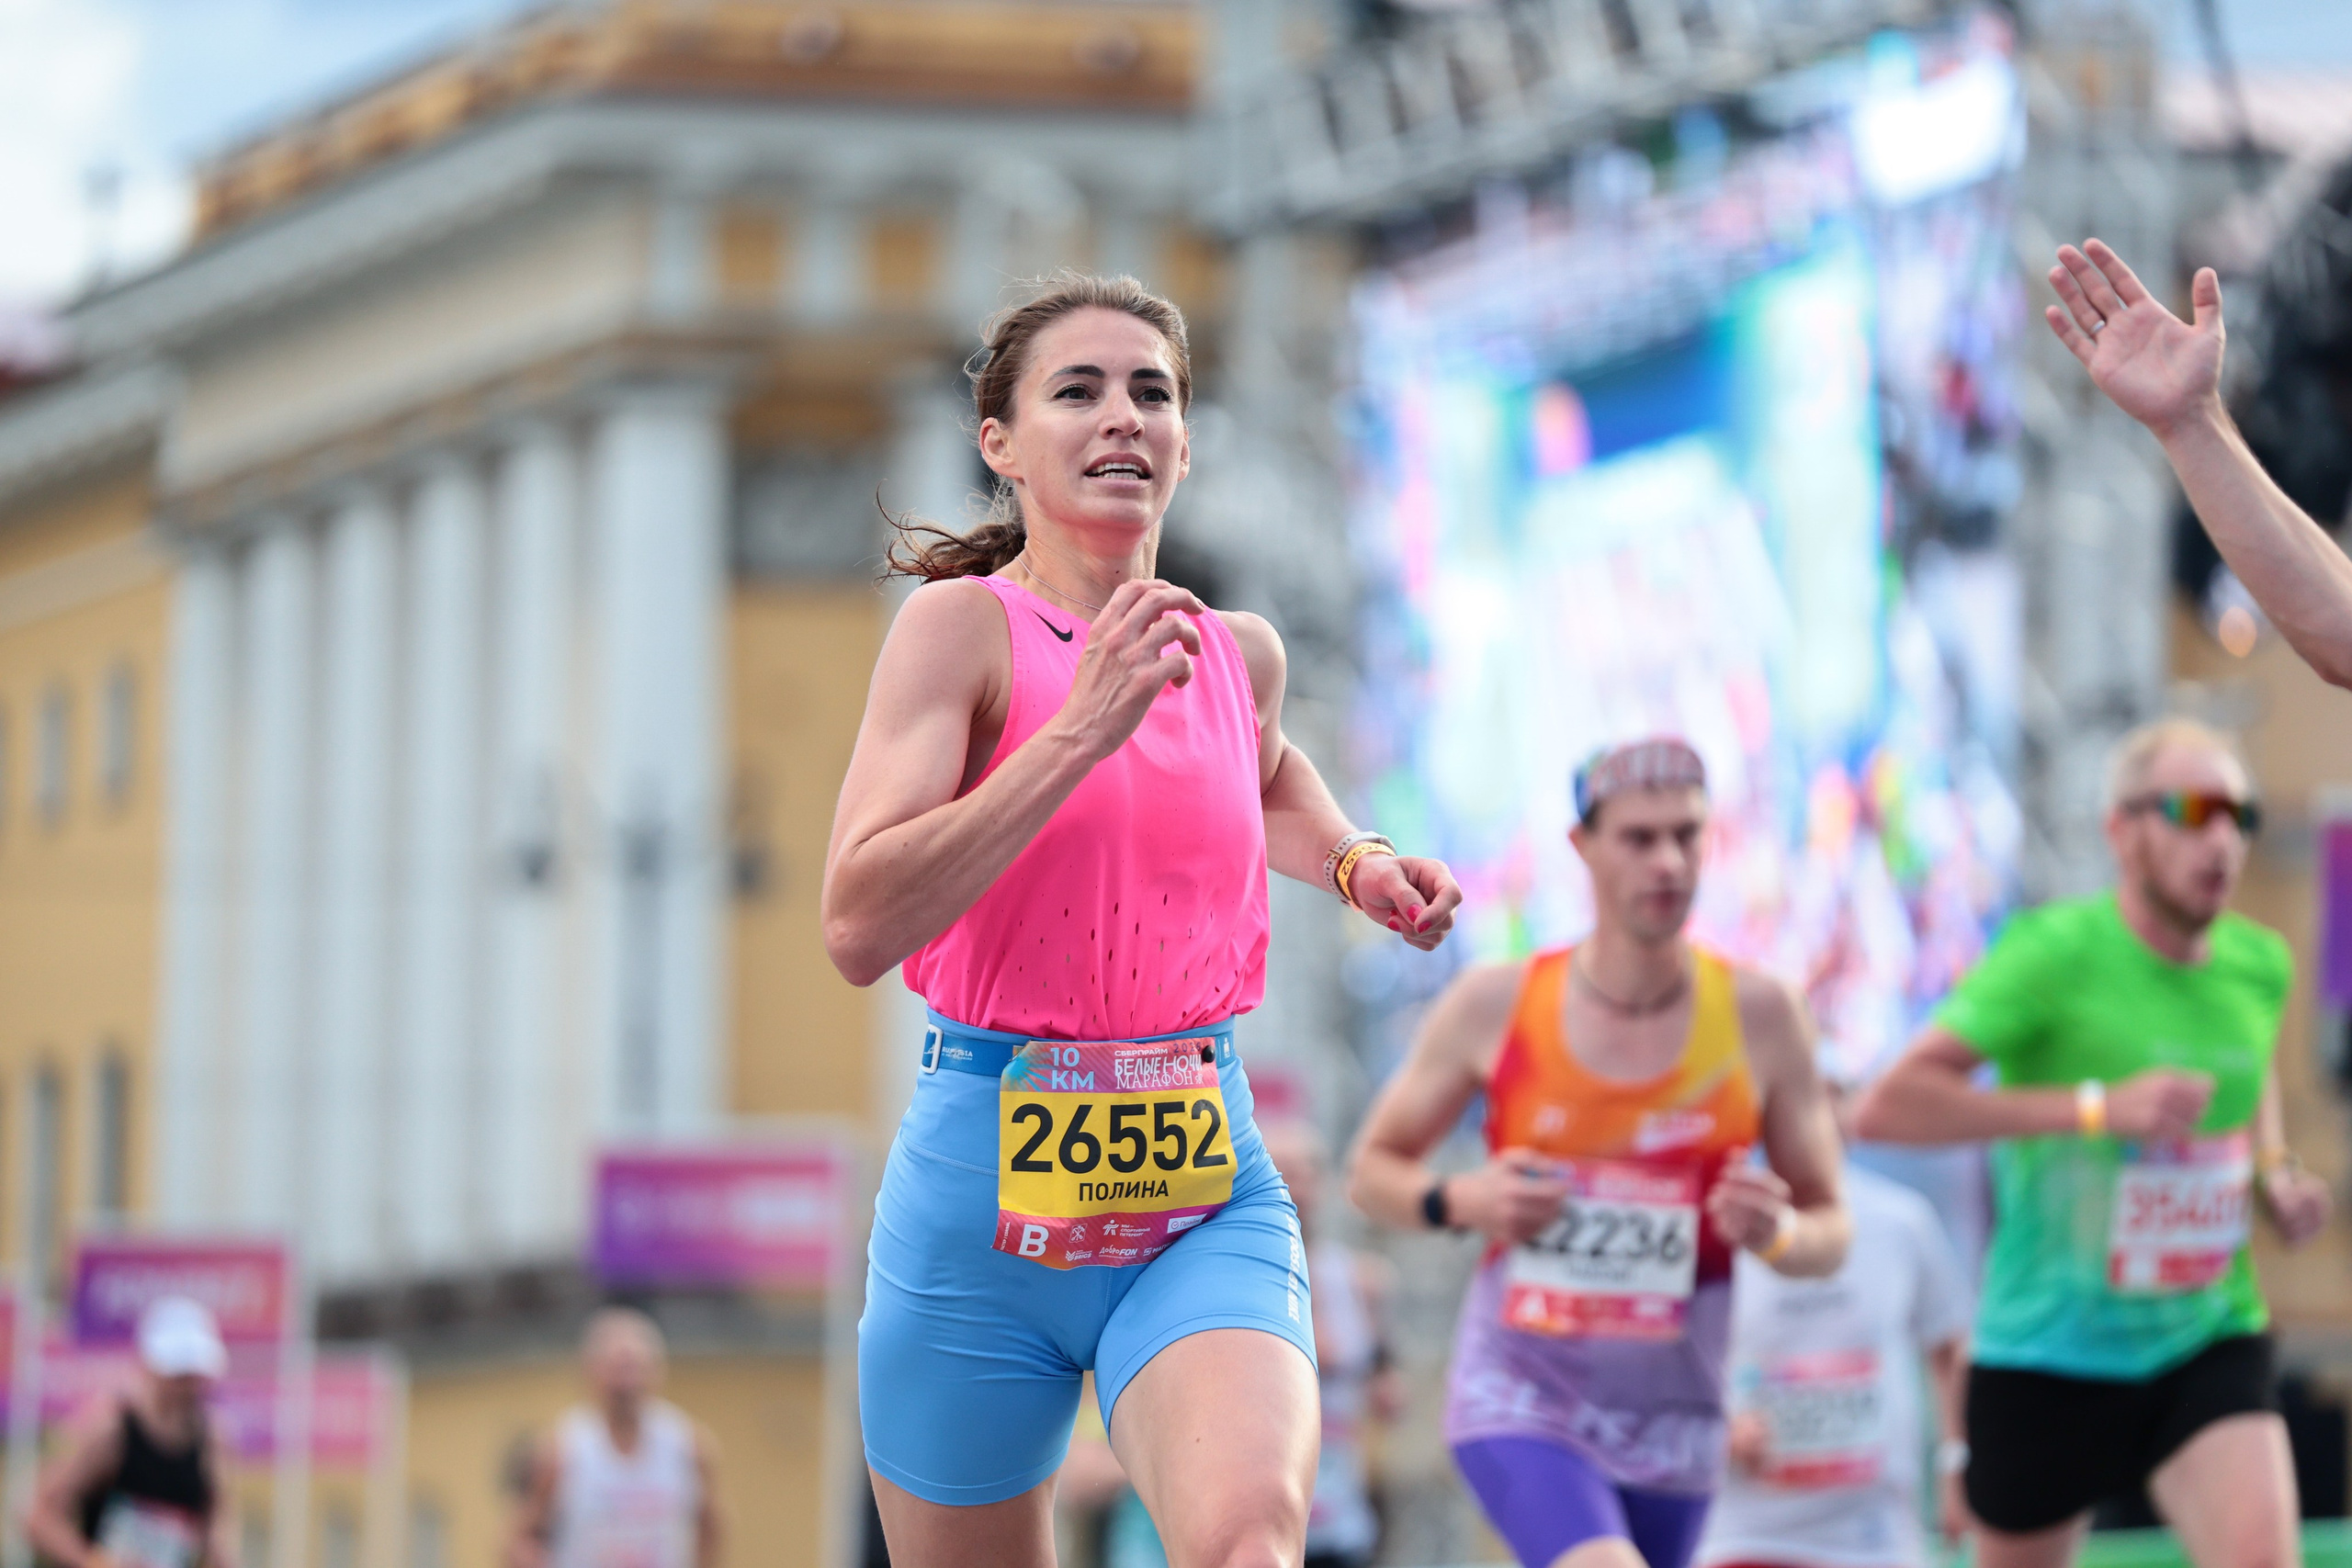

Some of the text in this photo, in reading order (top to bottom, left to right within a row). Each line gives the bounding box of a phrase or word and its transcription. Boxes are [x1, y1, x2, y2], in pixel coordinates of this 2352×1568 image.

[1050, 1046, 1080, 1067] 10
[1114, 1047, 1169, 1056] СБЕРПРАЙМ
[1114, 1054, 1203, 1077] БЕЛЫЕ НОЧИ
[1115, 1070, 1193, 1089] МАРАФОН
[1010, 1099, 1228, 1174] 26552
[1079, 1180, 1169, 1201] ПОЛИНА
